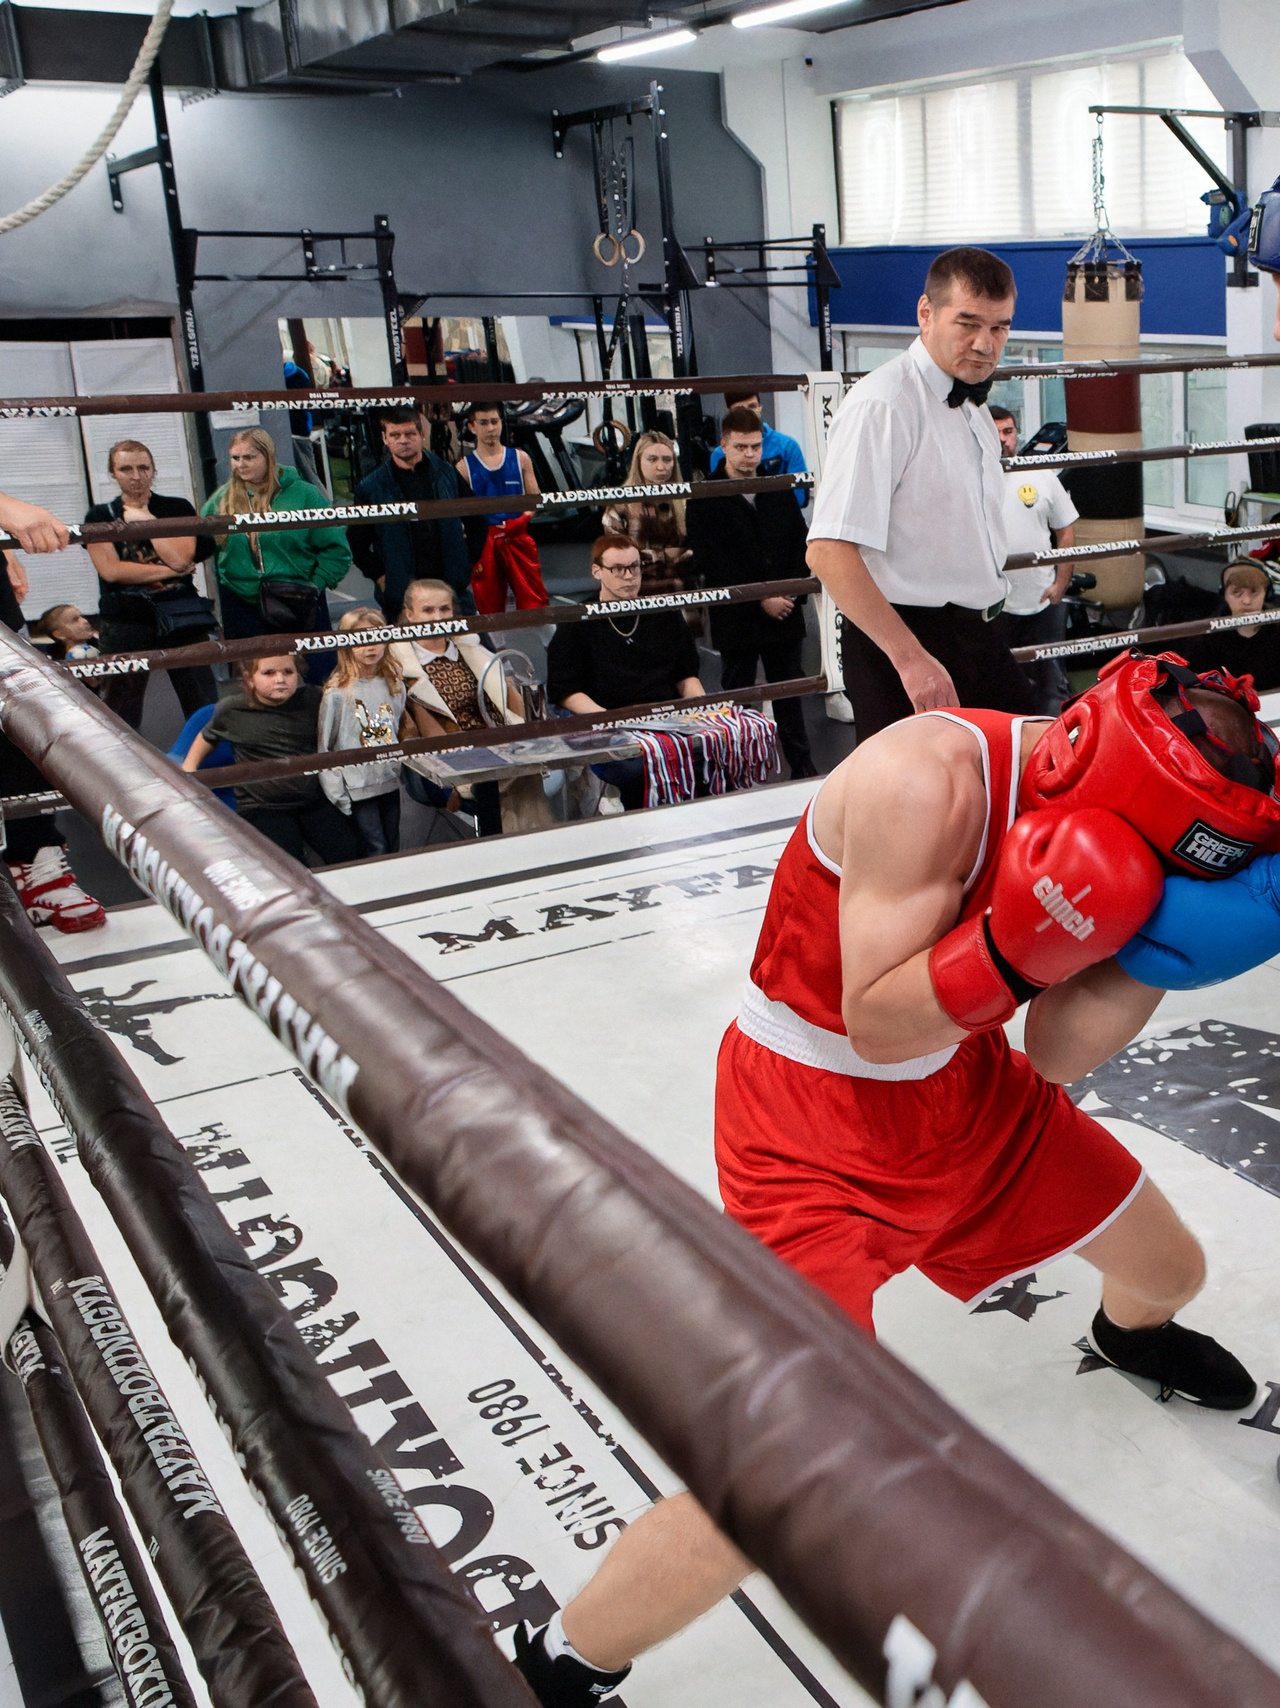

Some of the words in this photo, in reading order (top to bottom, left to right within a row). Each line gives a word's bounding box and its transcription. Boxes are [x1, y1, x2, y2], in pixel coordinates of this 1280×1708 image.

[541, 483, 692, 504] MAYFATBOXINGGYM
[234, 502, 418, 525] MAYFATBOXINGGYM
[585, 588, 732, 616] MAYFATBOXINGGYM
[294, 618, 469, 652] MAYFATBOXINGGYM
[1185, 840, 1228, 867] HILL
[1194, 832, 1244, 857] GREEN
[1032, 874, 1096, 941] clinch
[67, 1274, 223, 1520] MAYFATBOXINGGYM
[467, 1378, 551, 1447] 1980
[365, 1468, 411, 1511] SINCE
[285, 1493, 322, 1537] 1980
[303, 1525, 348, 1585] SINCE
